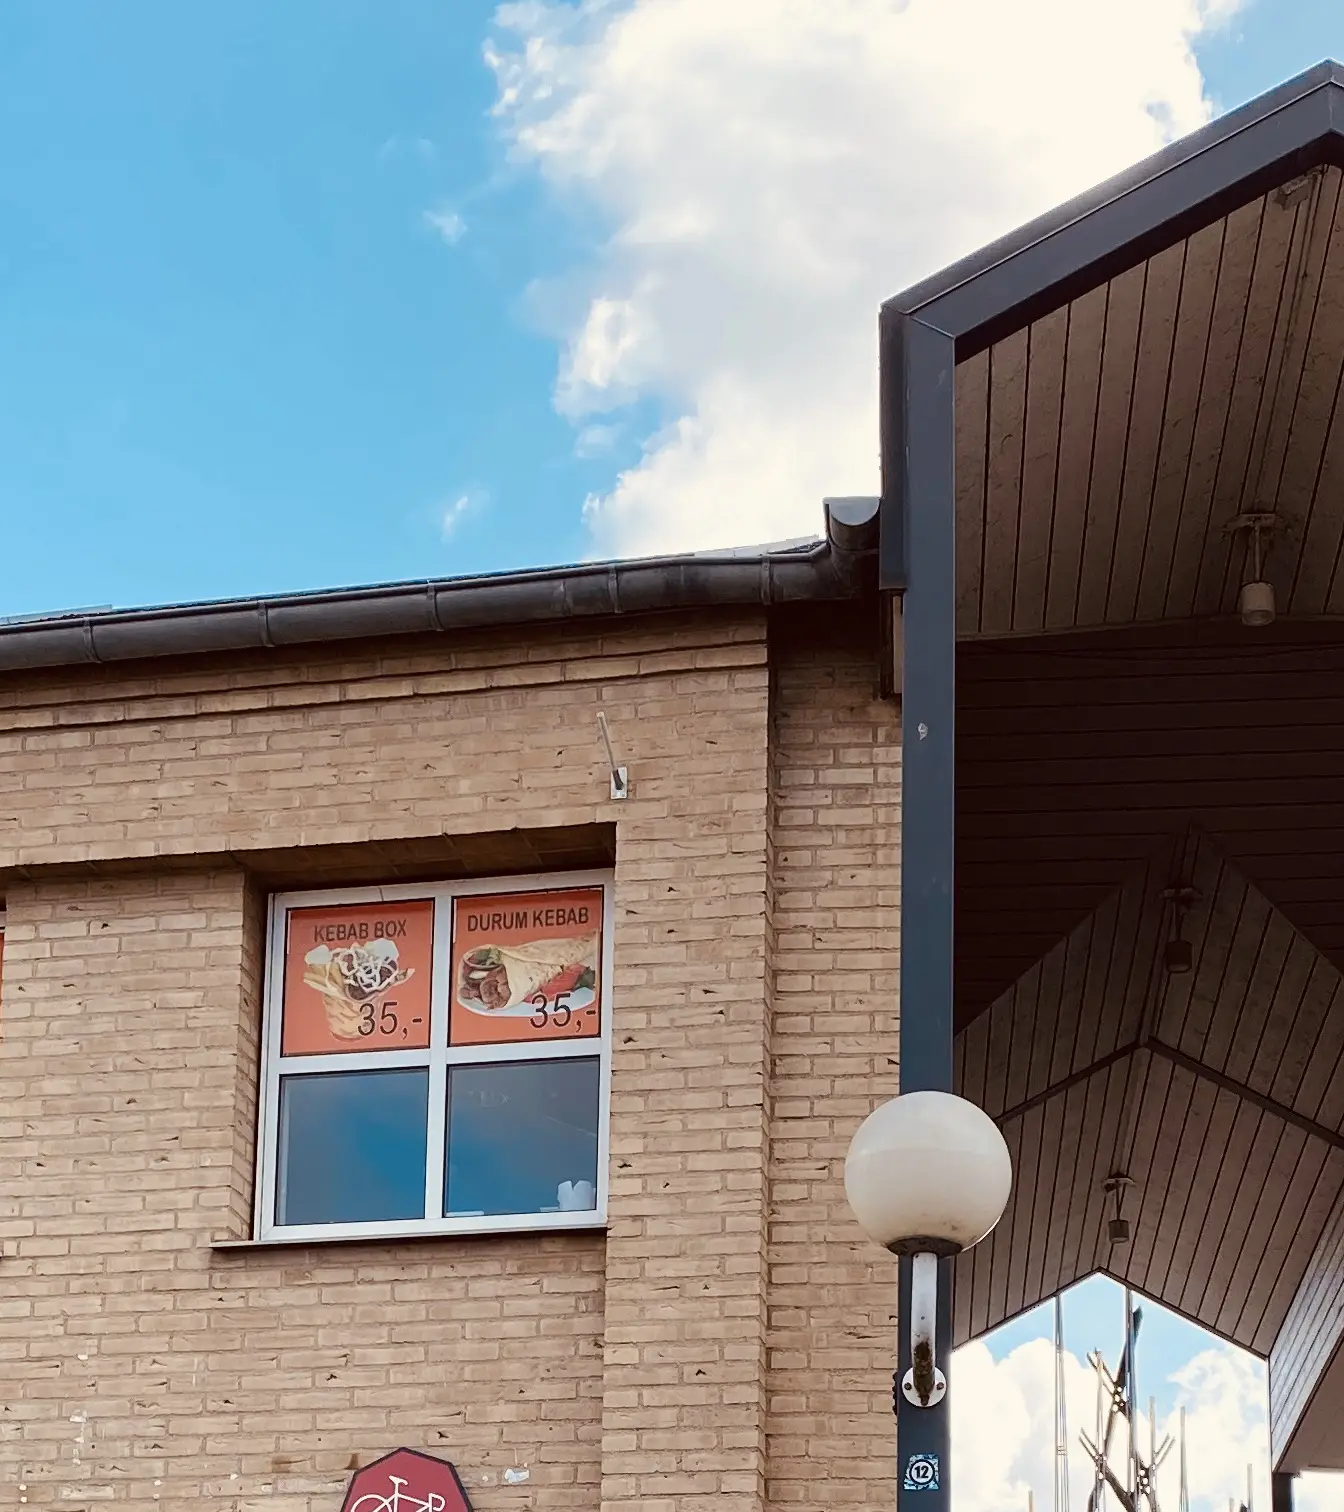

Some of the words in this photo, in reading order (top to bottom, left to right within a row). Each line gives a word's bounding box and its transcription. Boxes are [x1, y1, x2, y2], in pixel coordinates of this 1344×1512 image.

[314, 922, 369, 942] KEBAB
[374, 919, 408, 937] BOX
[467, 911, 528, 932] DURUM
[532, 906, 589, 927] KEBAB
[358, 1002, 423, 1039] 35,-
[530, 993, 597, 1033] 35,-
[914, 1464, 929, 1479] 12
